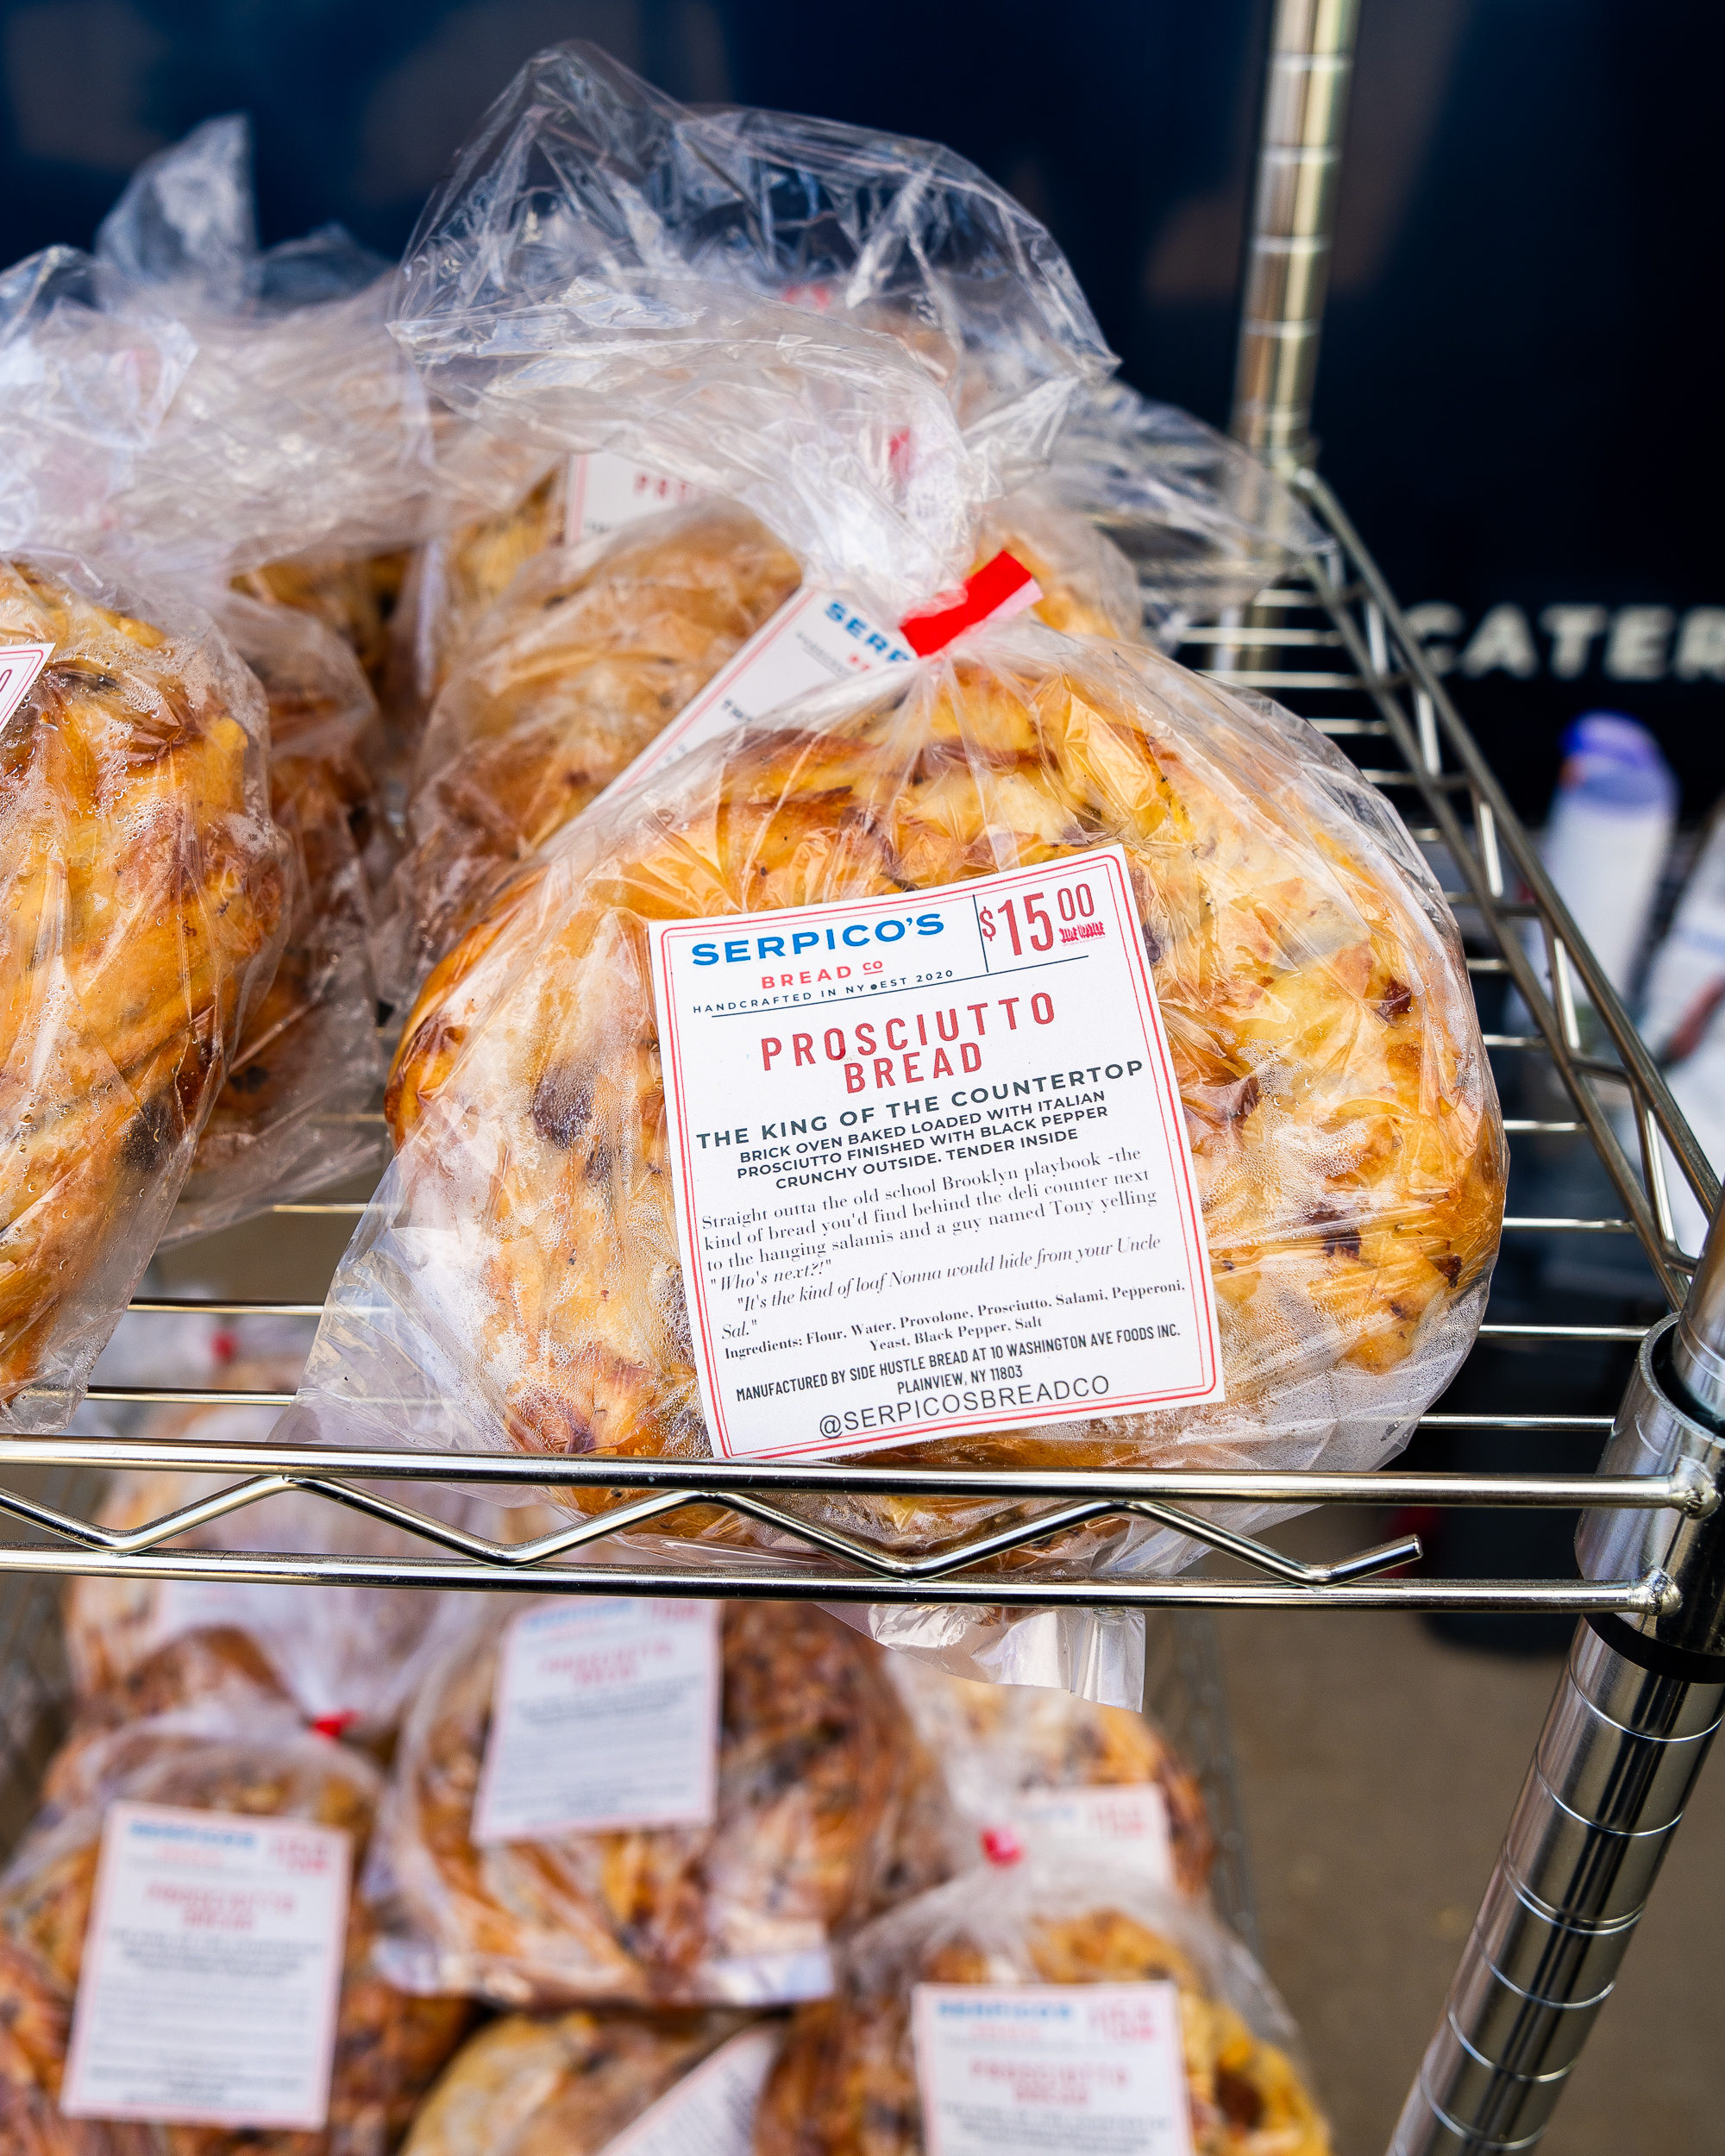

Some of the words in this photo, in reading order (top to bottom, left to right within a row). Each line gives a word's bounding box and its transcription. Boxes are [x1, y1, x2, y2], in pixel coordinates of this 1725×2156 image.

[692, 913, 944, 966] SERPICO'S
[693, 992, 812, 1013] HANDCRAFTED
[821, 988, 836, 998] IN
[846, 984, 864, 994] NY
[916, 969, 954, 982] 2020
[762, 965, 851, 989] BREAD
[862, 961, 883, 971] CO
[761, 993, 1055, 1071] PROSCIUTTO
[844, 1042, 982, 1094] BREAD
[696, 1128, 749, 1149] THE
[762, 1116, 827, 1139] KING
[839, 1106, 875, 1126] OF
[886, 1096, 939, 1118] THE
[951, 1060, 1143, 1106] COUNTERTOP
[740, 1145, 791, 1163] BRICK
[796, 1136, 843, 1153] OVEN
[848, 1125, 906, 1144] BAKED
[912, 1112, 982, 1134] LOADED
[987, 1104, 1032, 1120] WITH
[1038, 1090, 1105, 1112] ITALIAN
[737, 1153, 842, 1178] PROSCIUTTO
[847, 1138, 925, 1160] FINISHED
[930, 1129, 975, 1146] WITH
[981, 1119, 1037, 1138] BLACK
[1041, 1106, 1108, 1127] PEPPER
[775, 1166, 857, 1189] CRUNCHY
[862, 1152, 942, 1175] OUTSIDE.
[945, 1139, 1015, 1161] TENDER
[1021, 1129, 1078, 1148] INSIDE
[702, 1208, 767, 1230] Straight
[774, 1202, 816, 1219] outta
[822, 1195, 848, 1210] the
[853, 1188, 879, 1205] old
[885, 1179, 936, 1200] school
[942, 1167, 1018, 1191] Brooklyn
[1024, 1152, 1101, 1181] playbook
[1107, 1147, 1141, 1163] -the
[705, 1232, 741, 1250] kind
[747, 1228, 763, 1244] of
[768, 1219, 816, 1240] bread
[821, 1211, 869, 1236] you'd
[874, 1206, 906, 1223] find
[913, 1194, 971, 1217] behind
[975, 1190, 1001, 1206] the
[1008, 1183, 1038, 1200] deli
[1044, 1176, 1108, 1195] counter
[1113, 1169, 1149, 1185] next
[707, 1259, 722, 1272] to
[729, 1252, 754, 1269] the
[759, 1242, 826, 1263] hanging
[831, 1230, 894, 1250] salamis
[900, 1222, 931, 1240] and
[937, 1224, 945, 1234] a
[952, 1216, 982, 1236] guy
[988, 1203, 1045, 1225] named
[1050, 1198, 1094, 1216] Tony
[1101, 1190, 1157, 1213] yelling
[737, 1295, 767, 1312] "It's
[771, 1291, 795, 1307] the
[800, 1282, 833, 1301] kind
[837, 1278, 855, 1299] of
[856, 1272, 888, 1295] loaf
[889, 1269, 942, 1287] Nonna
[947, 1257, 994, 1278] would
[1000, 1251, 1032, 1270] hide
[1034, 1248, 1072, 1269] from
[1076, 1244, 1113, 1263] your
[1118, 1233, 1161, 1253] Uncle
[774, 1259, 831, 1283] next?!"
[722, 1319, 757, 1339] Sal."
[725, 1337, 803, 1360] Ingredients:
[914, 1328, 953, 1344] Black
[1014, 1316, 1043, 1330] Salt
[736, 1373, 827, 1401] MANUFACTURED
[831, 1369, 845, 1385] BY
[850, 1364, 875, 1382] SIDE
[880, 1357, 925, 1376] HUSTLE
[929, 1350, 968, 1368] BREAD
[972, 1348, 987, 1362] AT
[991, 1344, 1003, 1359] 10
[1006, 1335, 1087, 1357] WASHINGTON
[1090, 1331, 1113, 1346] AVE
[1116, 1326, 1154, 1344] FOODS
[1157, 1324, 1181, 1338] INC.
[897, 1372, 967, 1395] PLAINVIEW,
[970, 1369, 986, 1384] NY
[990, 1364, 1023, 1381] 11803
[819, 1375, 1109, 1438] @SERPICOSBREADCO
